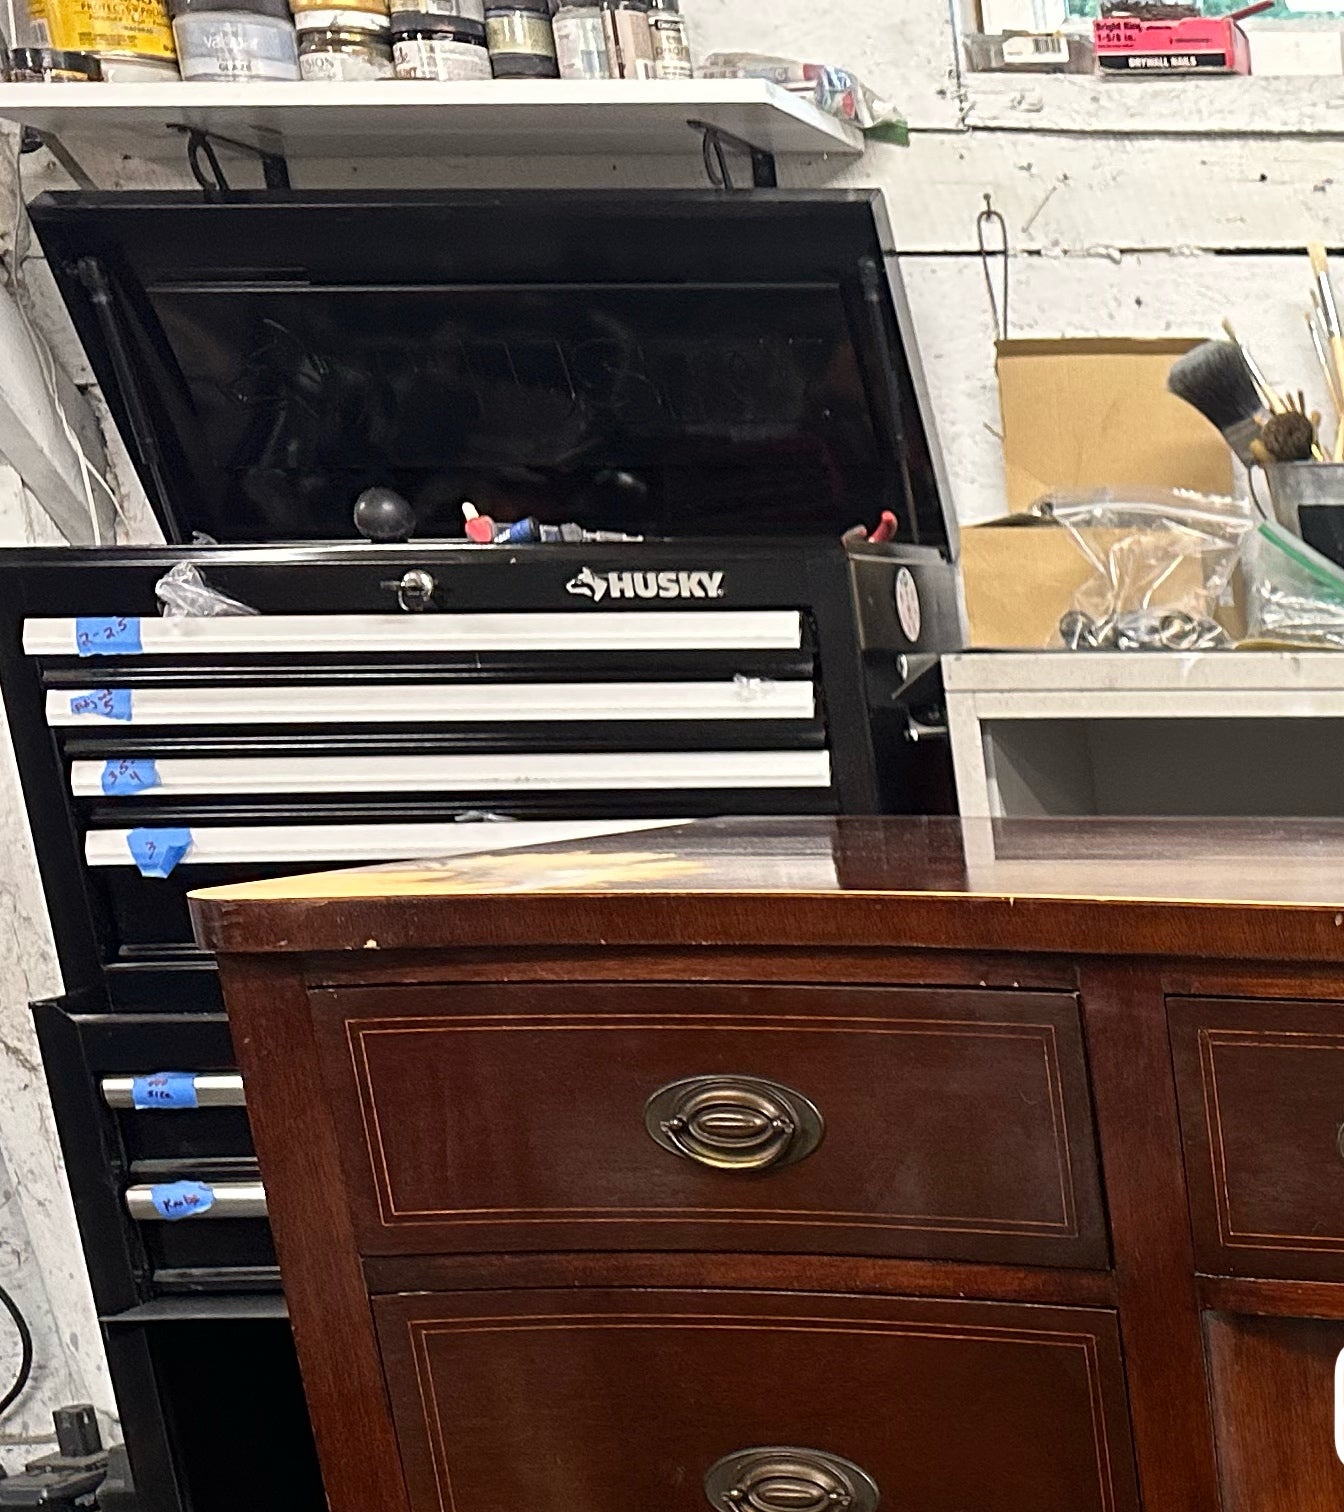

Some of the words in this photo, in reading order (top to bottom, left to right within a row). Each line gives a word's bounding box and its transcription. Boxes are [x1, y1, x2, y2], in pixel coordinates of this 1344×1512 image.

[1128, 56, 1170, 68] DRYWALL
[1170, 55, 1198, 67] NAILS
[608, 571, 724, 599] HUSKY
